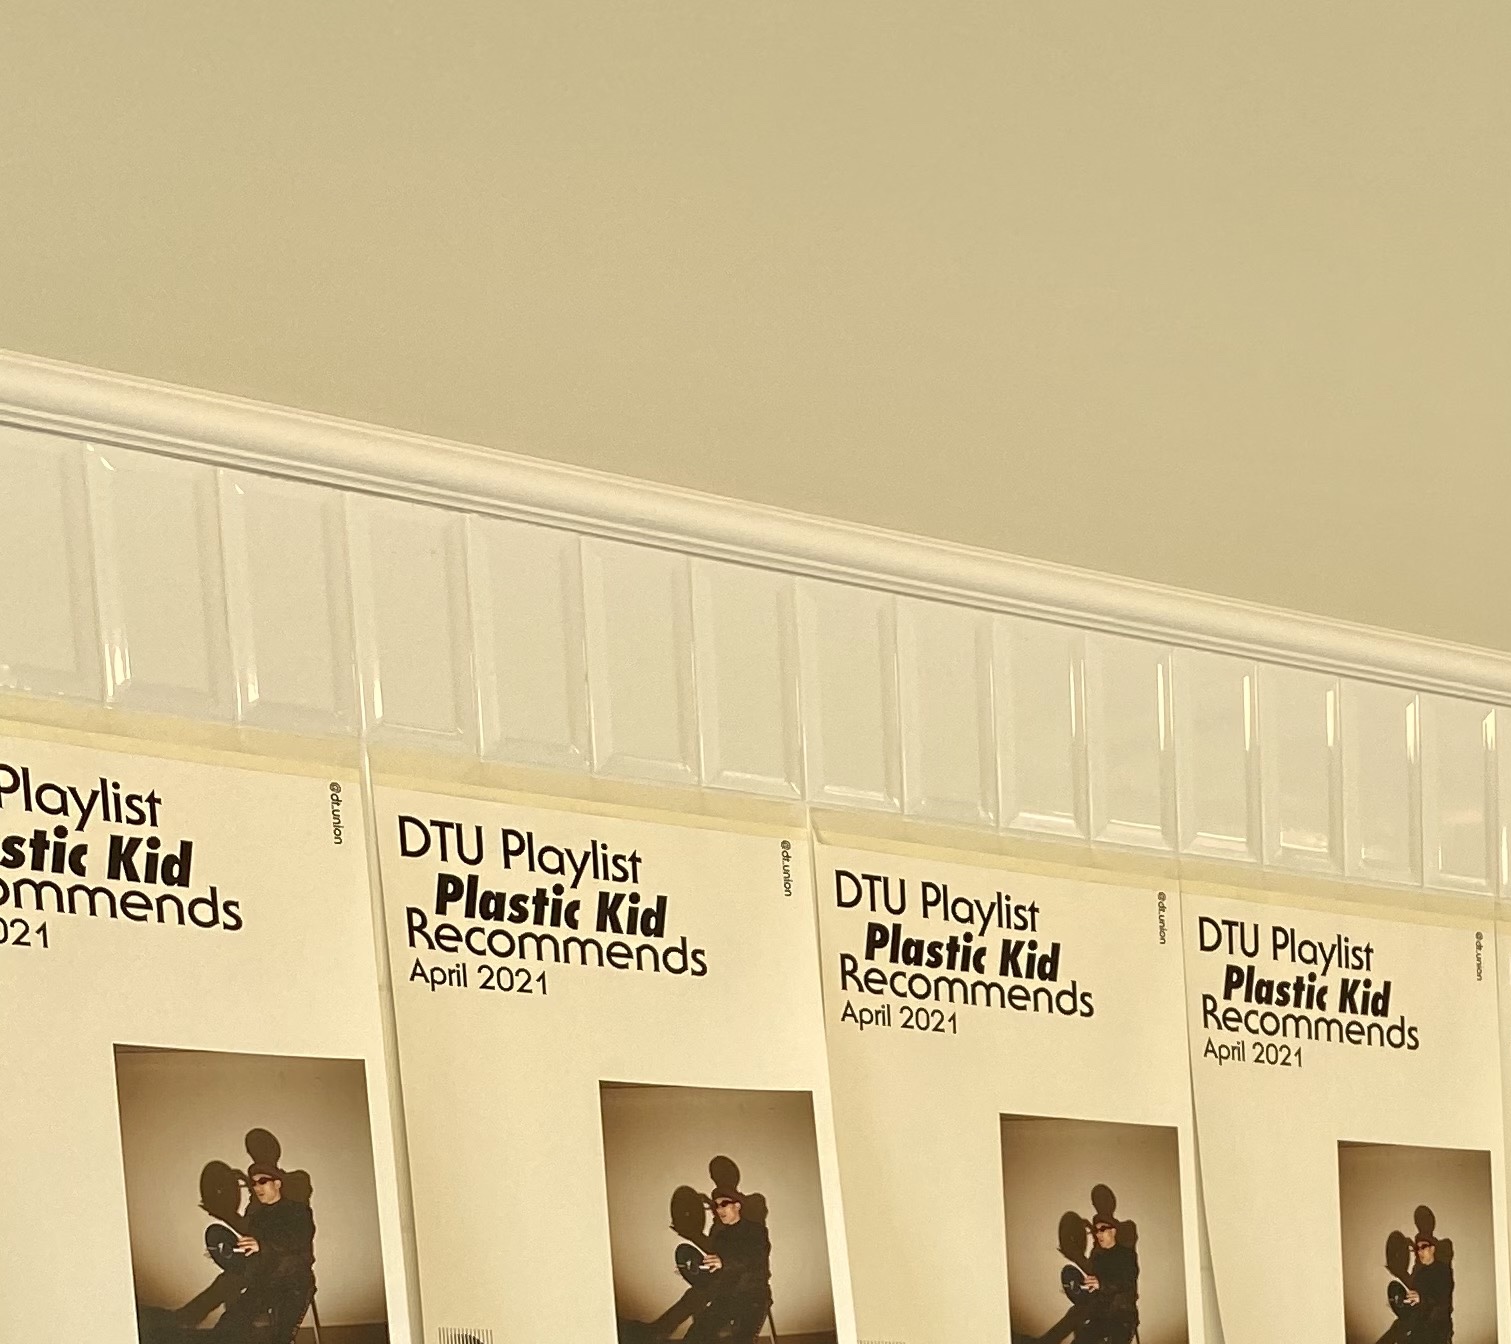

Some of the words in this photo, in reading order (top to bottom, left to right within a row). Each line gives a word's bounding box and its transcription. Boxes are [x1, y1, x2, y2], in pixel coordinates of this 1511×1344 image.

[0, 763, 163, 833] Playlist
[0, 824, 89, 878] stic
[106, 833, 194, 889] Kid
[397, 814, 484, 867] DTU
[500, 827, 643, 890] Playlist
[0, 877, 243, 932] mmends
[434, 872, 581, 931] Plastic
[595, 890, 668, 939] Kid
[834, 869, 907, 916] DTU
[920, 880, 1040, 938] Playlist
[405, 905, 708, 977] Recommends
[864, 921, 988, 975] Plastic
[998, 938, 1061, 983] Kid
[1198, 915, 1260, 959] DTU
[1271, 925, 1375, 977] Playlist
[409, 956, 468, 993] April
[476, 964, 548, 996] 2021
[839, 952, 1095, 1018] Recommends
[1222, 963, 1329, 1013] Plastic
[1338, 977, 1392, 1019] Kid
[840, 999, 892, 1032] April
[898, 1005, 957, 1035] 2021
[1201, 993, 1420, 1051] Recommends
[1203, 1036, 1246, 1067] April
[1251, 1041, 1303, 1068] 2021
